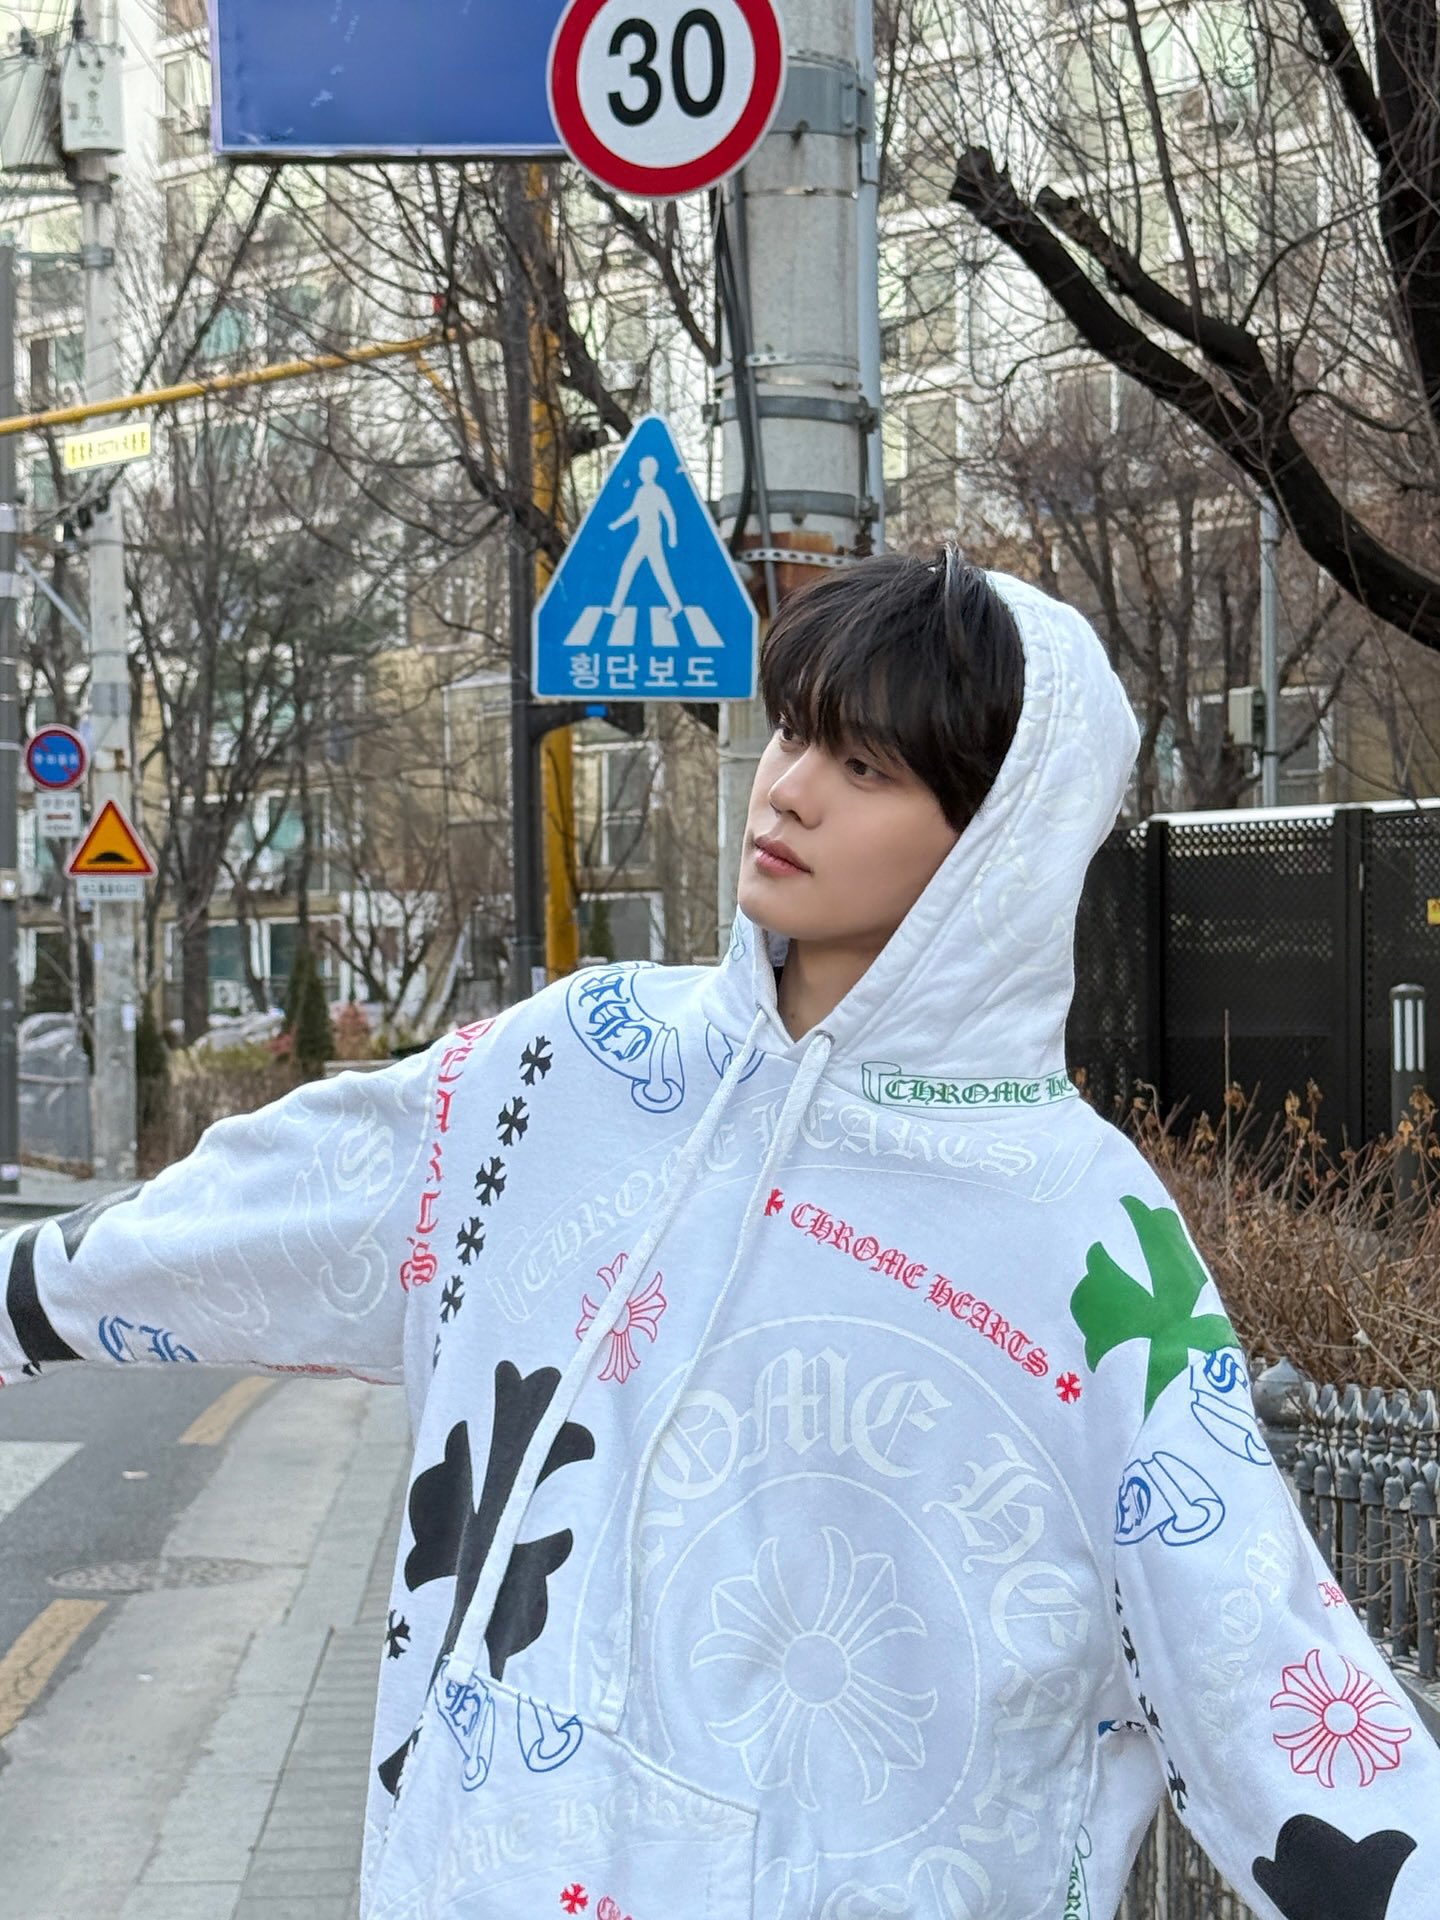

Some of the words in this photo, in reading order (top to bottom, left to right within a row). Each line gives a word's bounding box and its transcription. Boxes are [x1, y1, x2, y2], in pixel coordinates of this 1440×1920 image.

[608, 8, 726, 127] 30
[569, 652, 718, 690] 횡단보도
[885, 1079, 1041, 1105] CHROME
[790, 1203, 928, 1289] CHROME
[923, 1273, 1049, 1378] HEARTS
